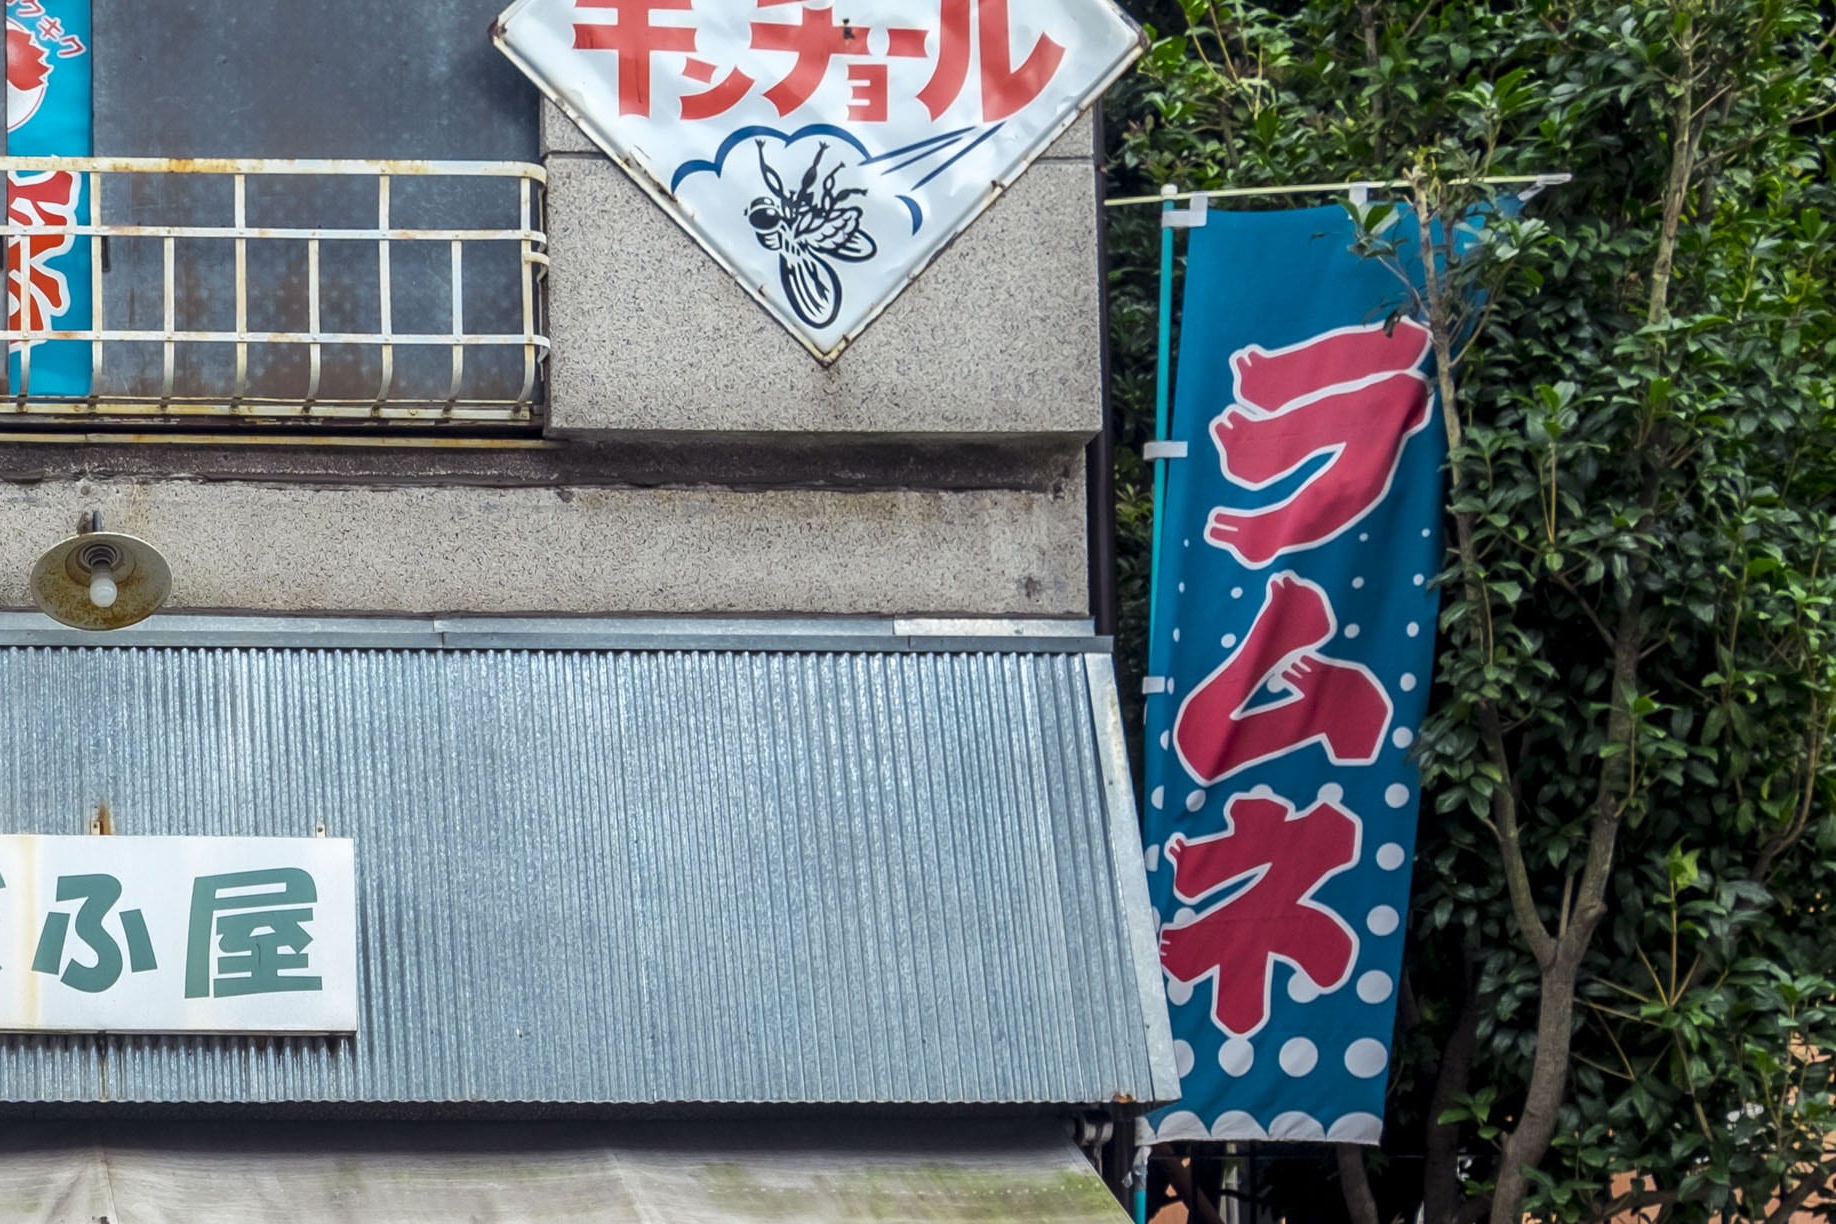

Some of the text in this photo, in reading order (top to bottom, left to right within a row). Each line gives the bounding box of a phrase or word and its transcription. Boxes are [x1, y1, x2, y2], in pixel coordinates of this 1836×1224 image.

[573, 0, 1066, 123] キンチョール
[1160, 316, 1435, 1039] ラムネ
